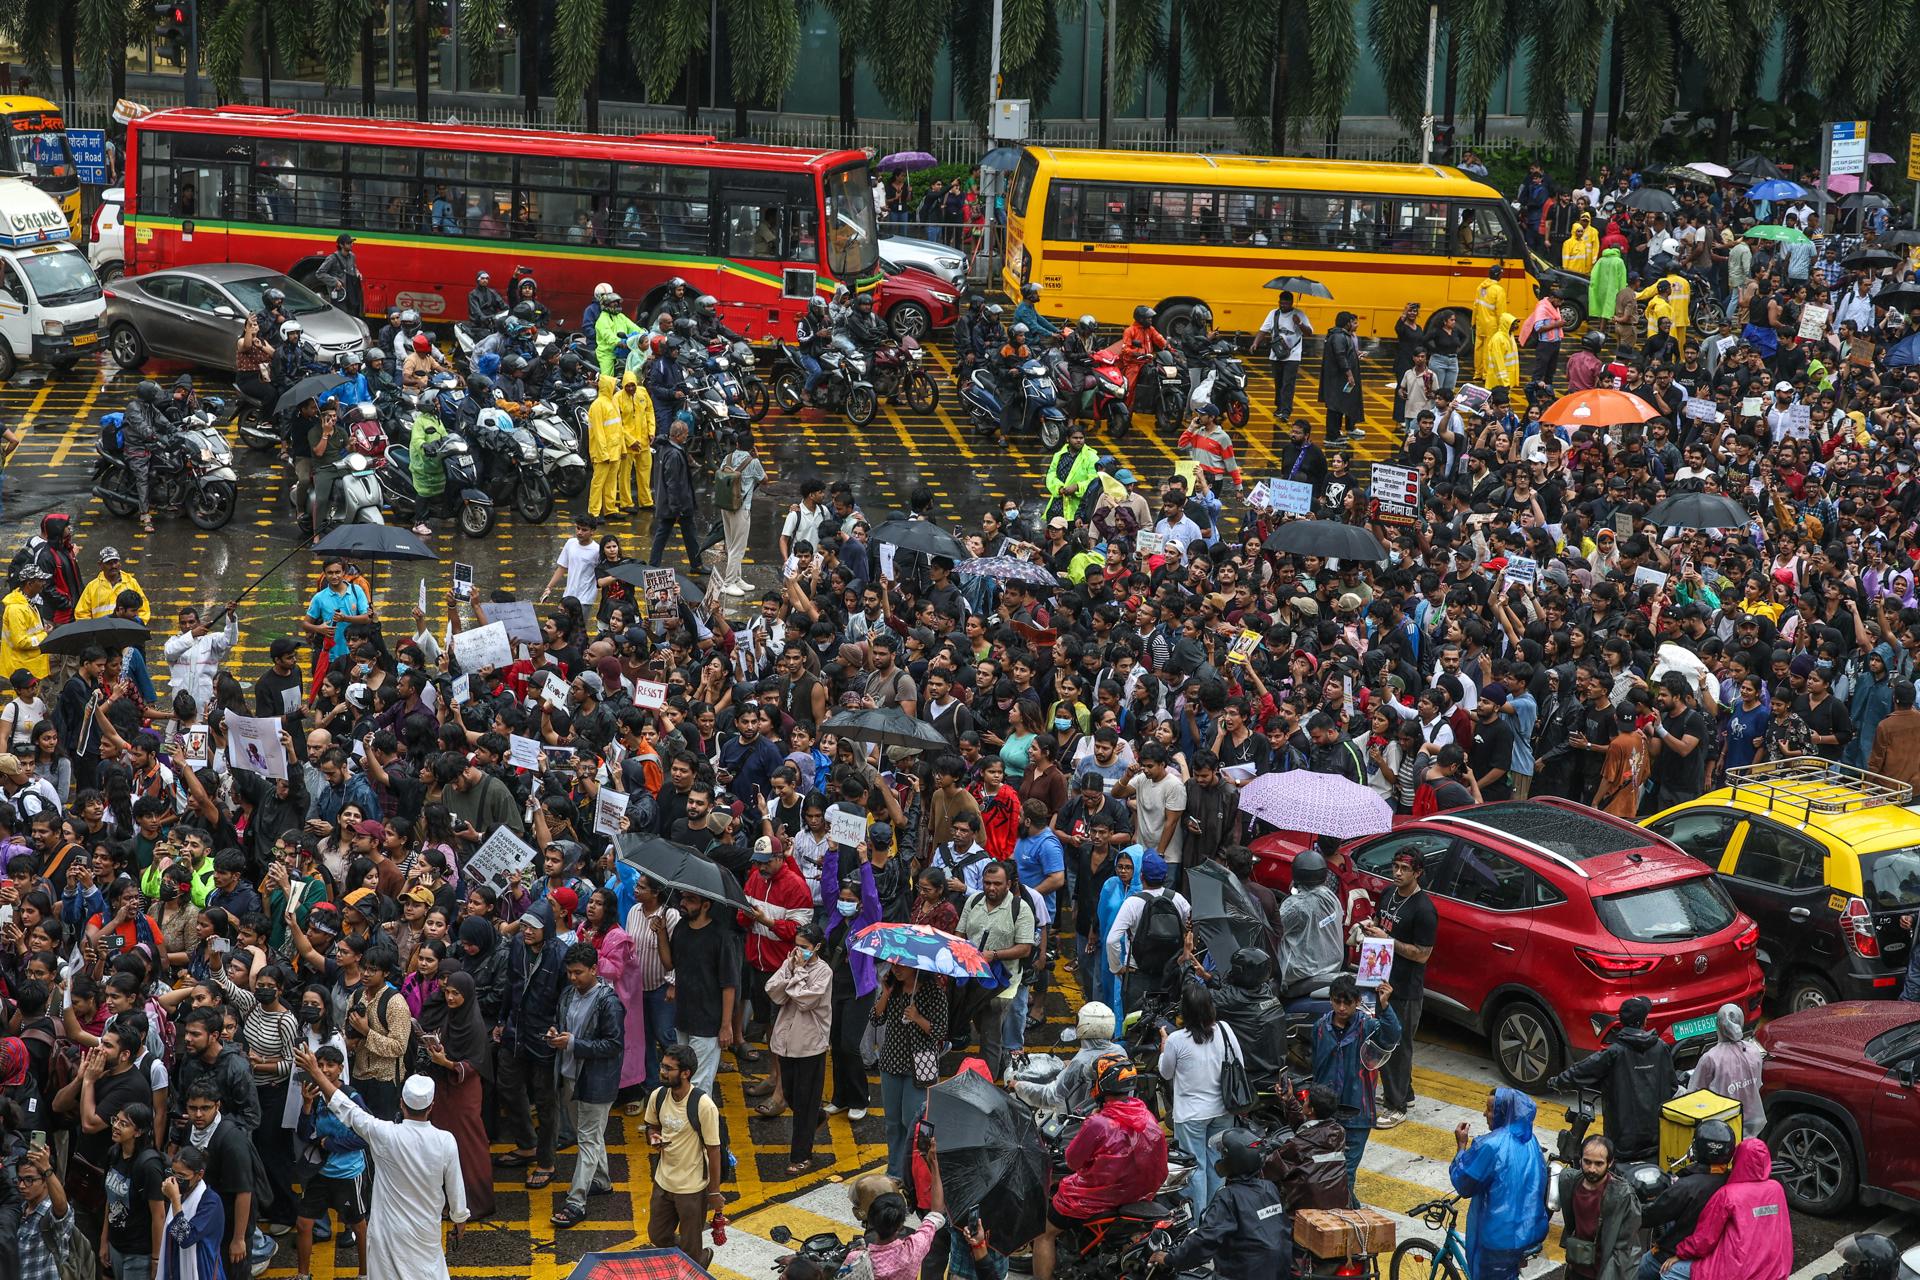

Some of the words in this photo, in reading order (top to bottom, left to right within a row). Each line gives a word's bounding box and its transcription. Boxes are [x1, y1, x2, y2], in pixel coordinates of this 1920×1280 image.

[84, 152, 102, 162] Road
[546, 678, 564, 699] REVOLT
[637, 685, 663, 699] RESIST
[1679, 1018, 1719, 1036] MH01ER50
